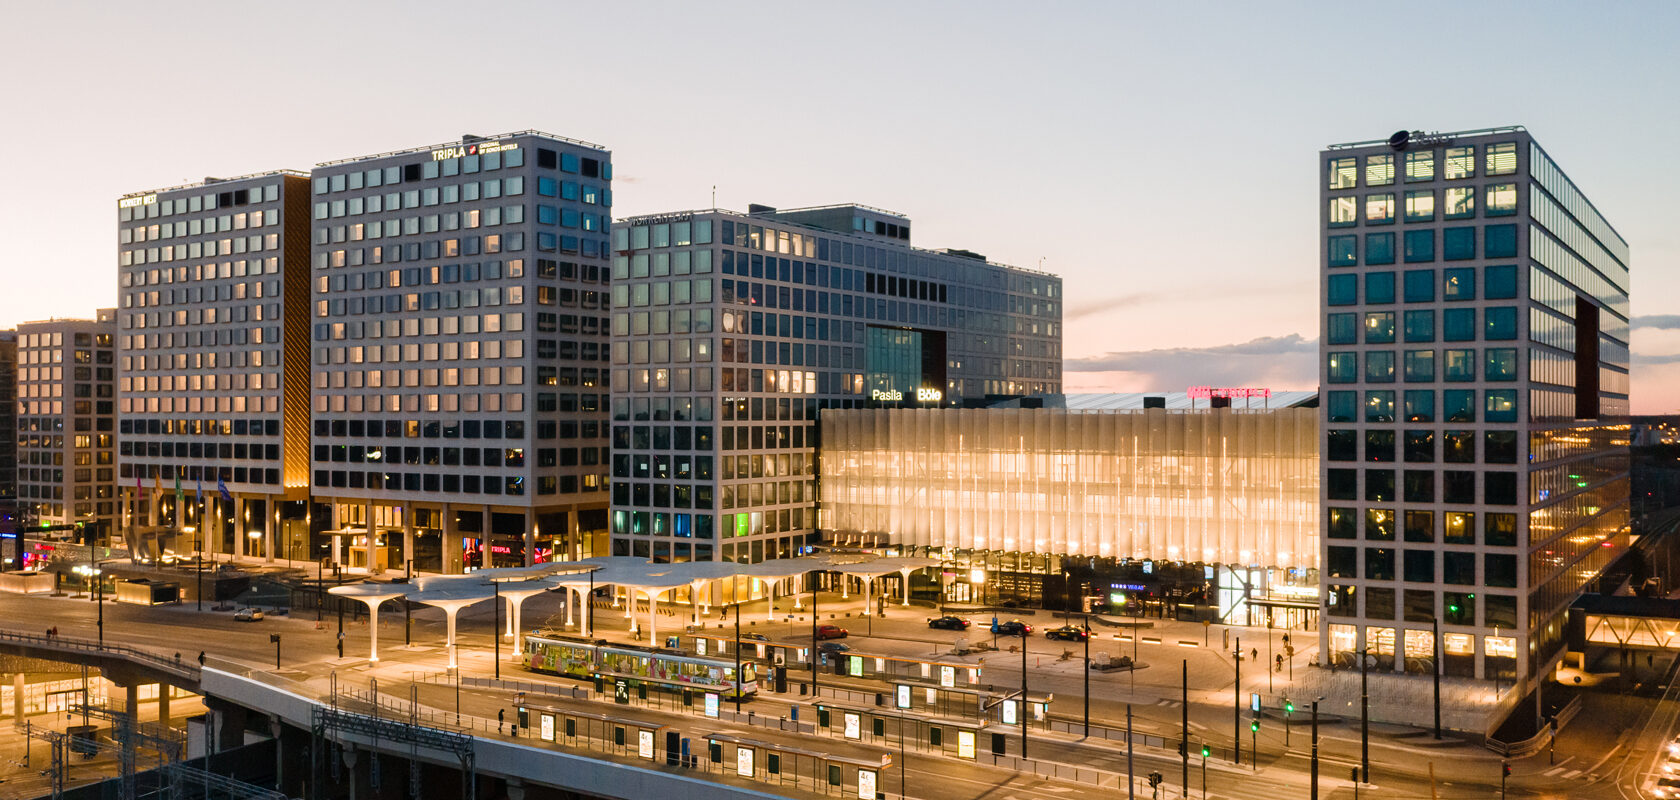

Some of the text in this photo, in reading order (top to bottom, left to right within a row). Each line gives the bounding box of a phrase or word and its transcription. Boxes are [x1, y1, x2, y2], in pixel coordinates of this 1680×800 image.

[432, 147, 466, 161] TRIPLA
[872, 387, 941, 401] Pasila Böle
